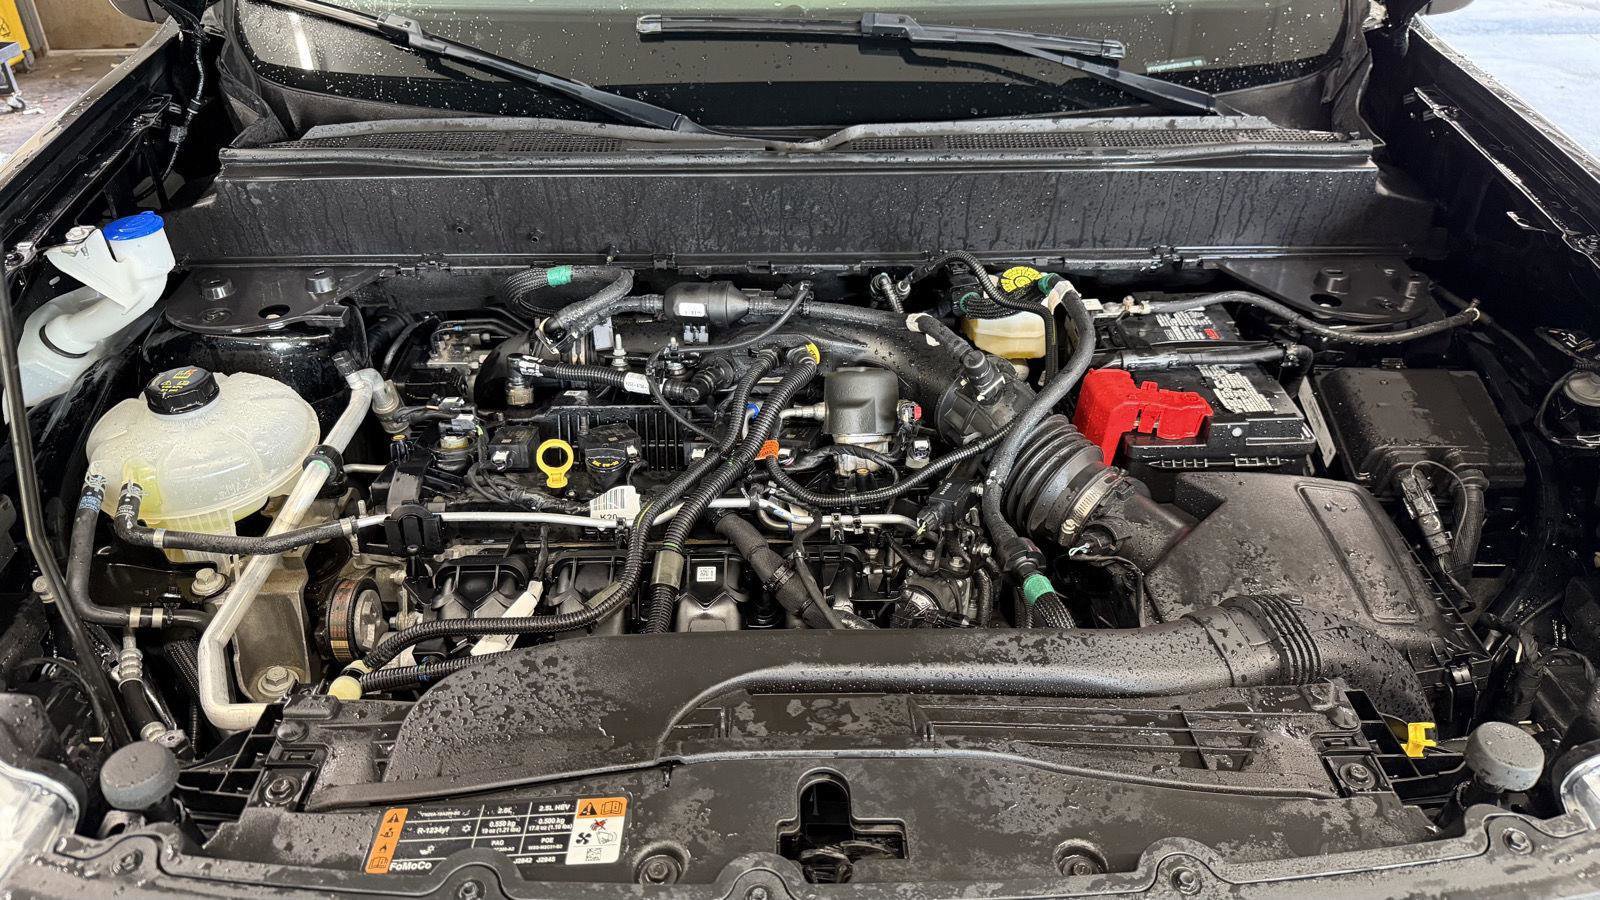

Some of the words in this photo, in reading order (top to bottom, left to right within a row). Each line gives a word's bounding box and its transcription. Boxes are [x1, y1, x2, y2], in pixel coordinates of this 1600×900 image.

[554, 803, 571, 811] HEV
[507, 820, 517, 828] kg
[538, 817, 556, 825] 0.500
[556, 817, 566, 825] kg
[417, 826, 450, 835] R-1234yf
[389, 860, 432, 871] FoMoCo
